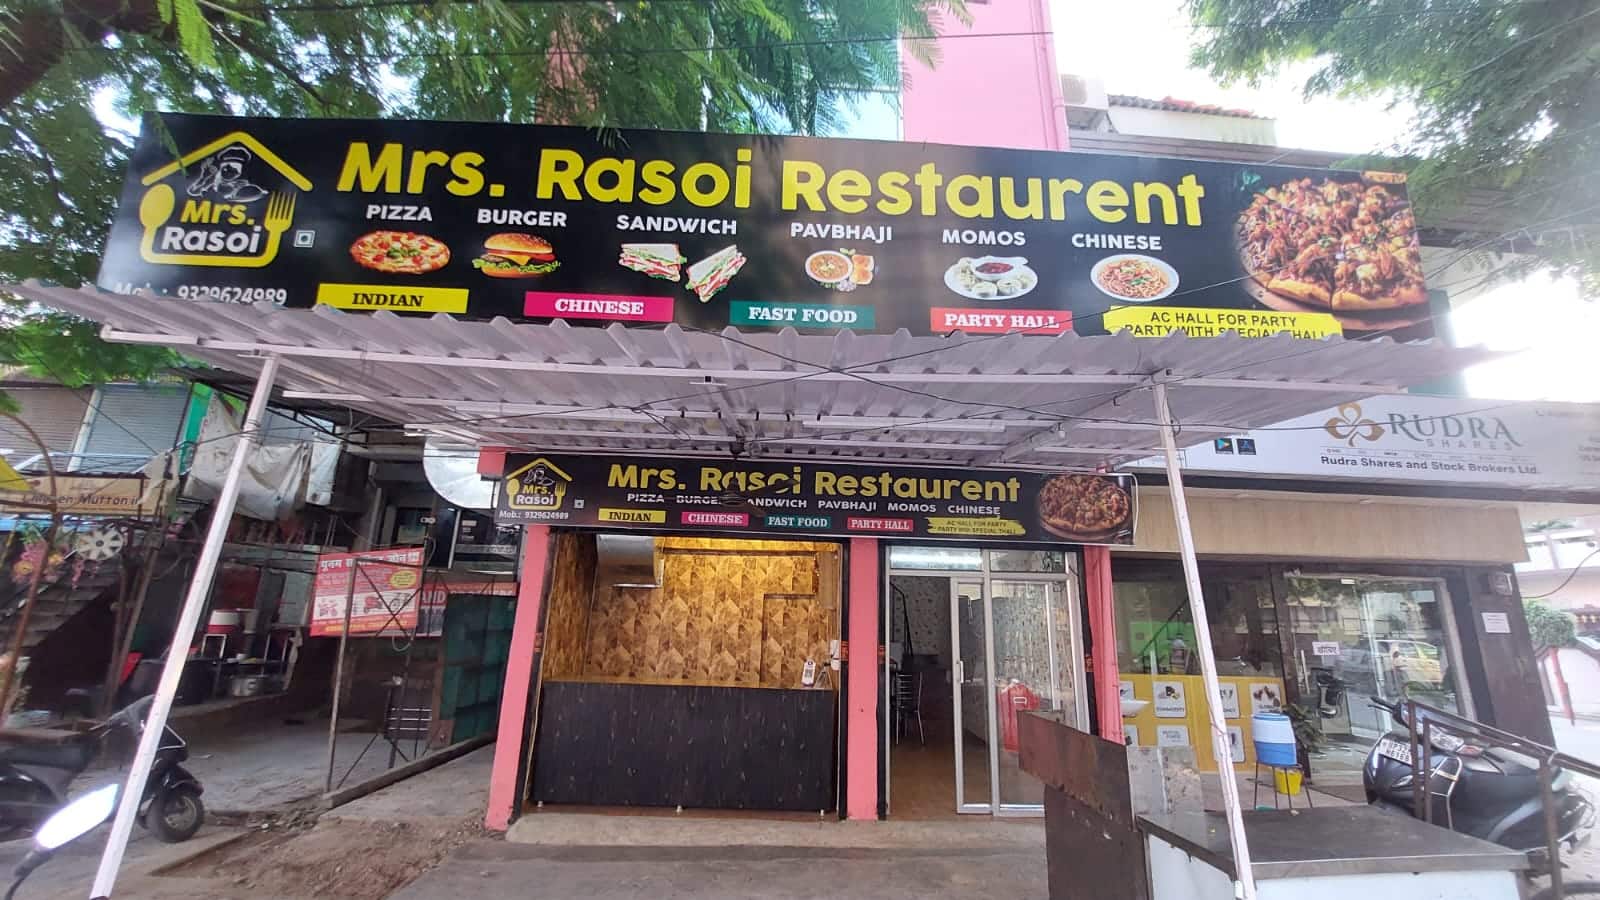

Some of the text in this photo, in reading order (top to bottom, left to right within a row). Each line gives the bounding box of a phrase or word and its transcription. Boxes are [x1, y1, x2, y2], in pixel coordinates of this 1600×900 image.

[337, 142, 1206, 227] Mrs. Rasoi Restaurent
[180, 200, 255, 225] Mrs.
[366, 205, 432, 222] PIZZA
[477, 208, 567, 227] BURGER
[616, 214, 737, 235] SANDWICH
[790, 222, 892, 242] PAVBHAJI
[161, 225, 262, 253] Rasoi
[942, 229, 1026, 247] MOMOS
[1072, 232, 1162, 251] CHINESE
[351, 292, 424, 308] INDIAN
[554, 298, 644, 316] CHINESE
[749, 307, 857, 323] FAST FOOD
[945, 313, 1059, 329] PARTY HALL
[1150, 311, 1297, 327] AC HALL FOR PARTY
[1387, 412, 1524, 447] RUDRA
[1426, 438, 1513, 451] SHARES
[1320, 456, 1357, 465] Rudra
[1361, 457, 1402, 468] Shares
[1406, 460, 1428, 469] and
[1431, 461, 1465, 471] Stock
[1468, 463, 1516, 473] Brokers
[522, 484, 551, 494] Mrs.
[607, 463, 1021, 503] Mrs. Rasoi Restaurent
[516, 494, 554, 505] Rasoi
[627, 493, 665, 503] PIZZA
[676, 494, 722, 505] BURGE
[818, 500, 877, 512] PAVBHAJI
[887, 502, 937, 513] MOMOS
[947, 504, 1000, 515] CHINESE
[608, 511, 651, 521] INDIAN
[688, 514, 743, 524] CHINESE
[768, 516, 828, 528] FAST FOOD
[851, 519, 910, 530] PARTY HALL
